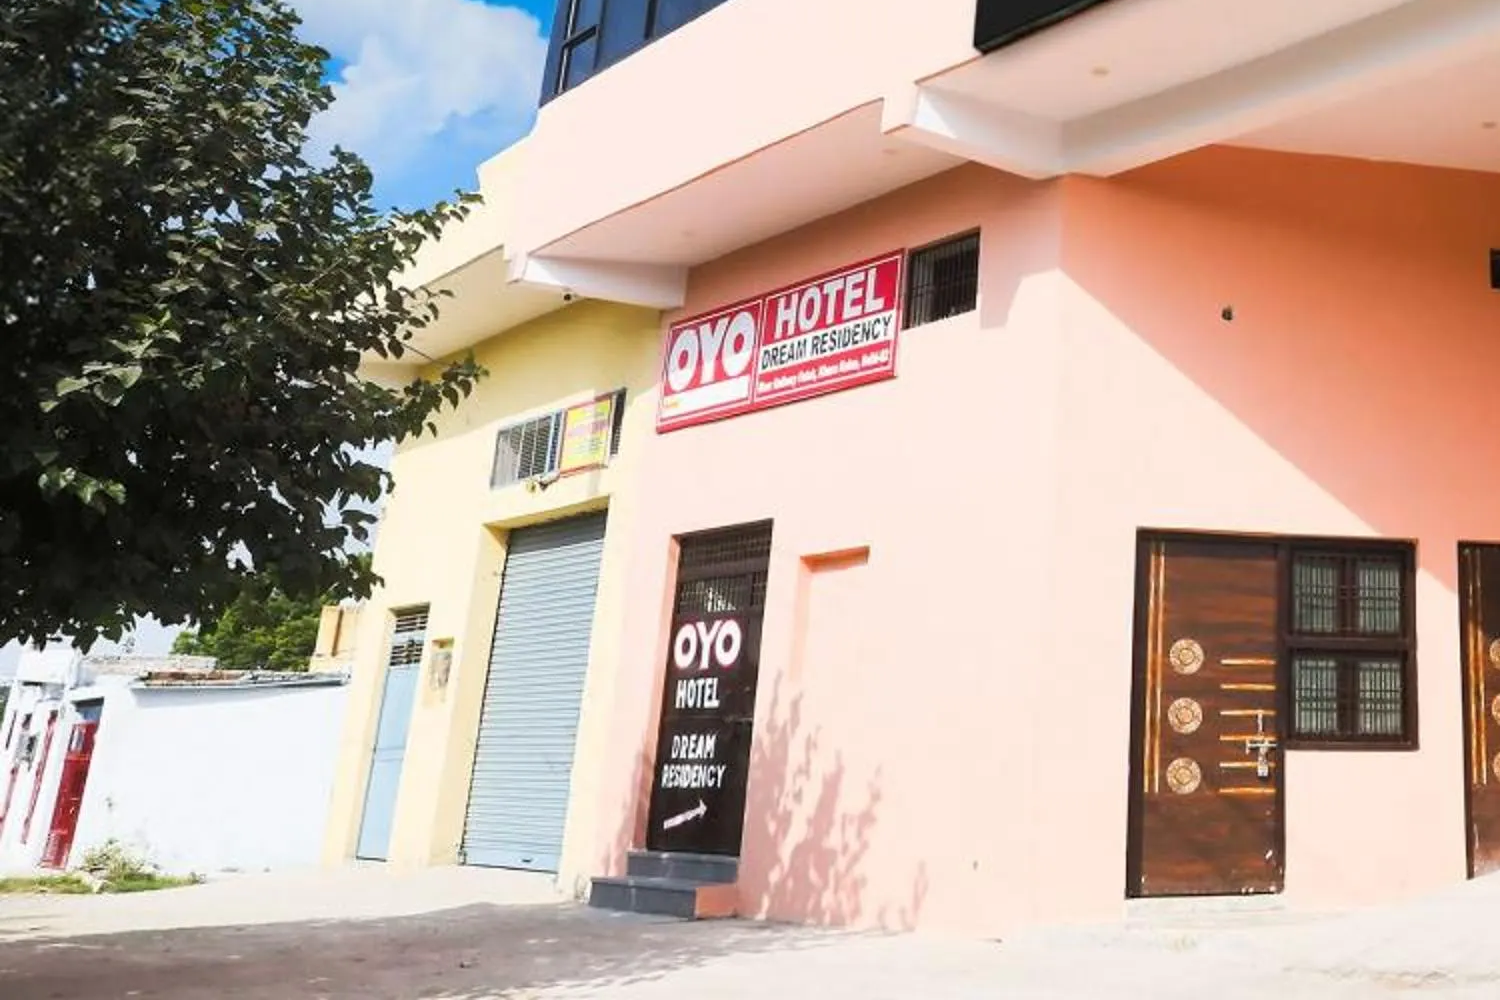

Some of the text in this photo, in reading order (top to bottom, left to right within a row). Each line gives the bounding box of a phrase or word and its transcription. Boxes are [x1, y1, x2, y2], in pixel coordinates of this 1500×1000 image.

[773, 266, 885, 340] HOTEL
[667, 311, 757, 393] OYO
[761, 338, 808, 371] DREAM
[811, 314, 893, 356] RESIDENCY
[673, 619, 743, 671] OYO
[675, 677, 721, 710] HOTEL
[671, 733, 717, 760] DREAM
[661, 764, 727, 790] RESIDENCY
